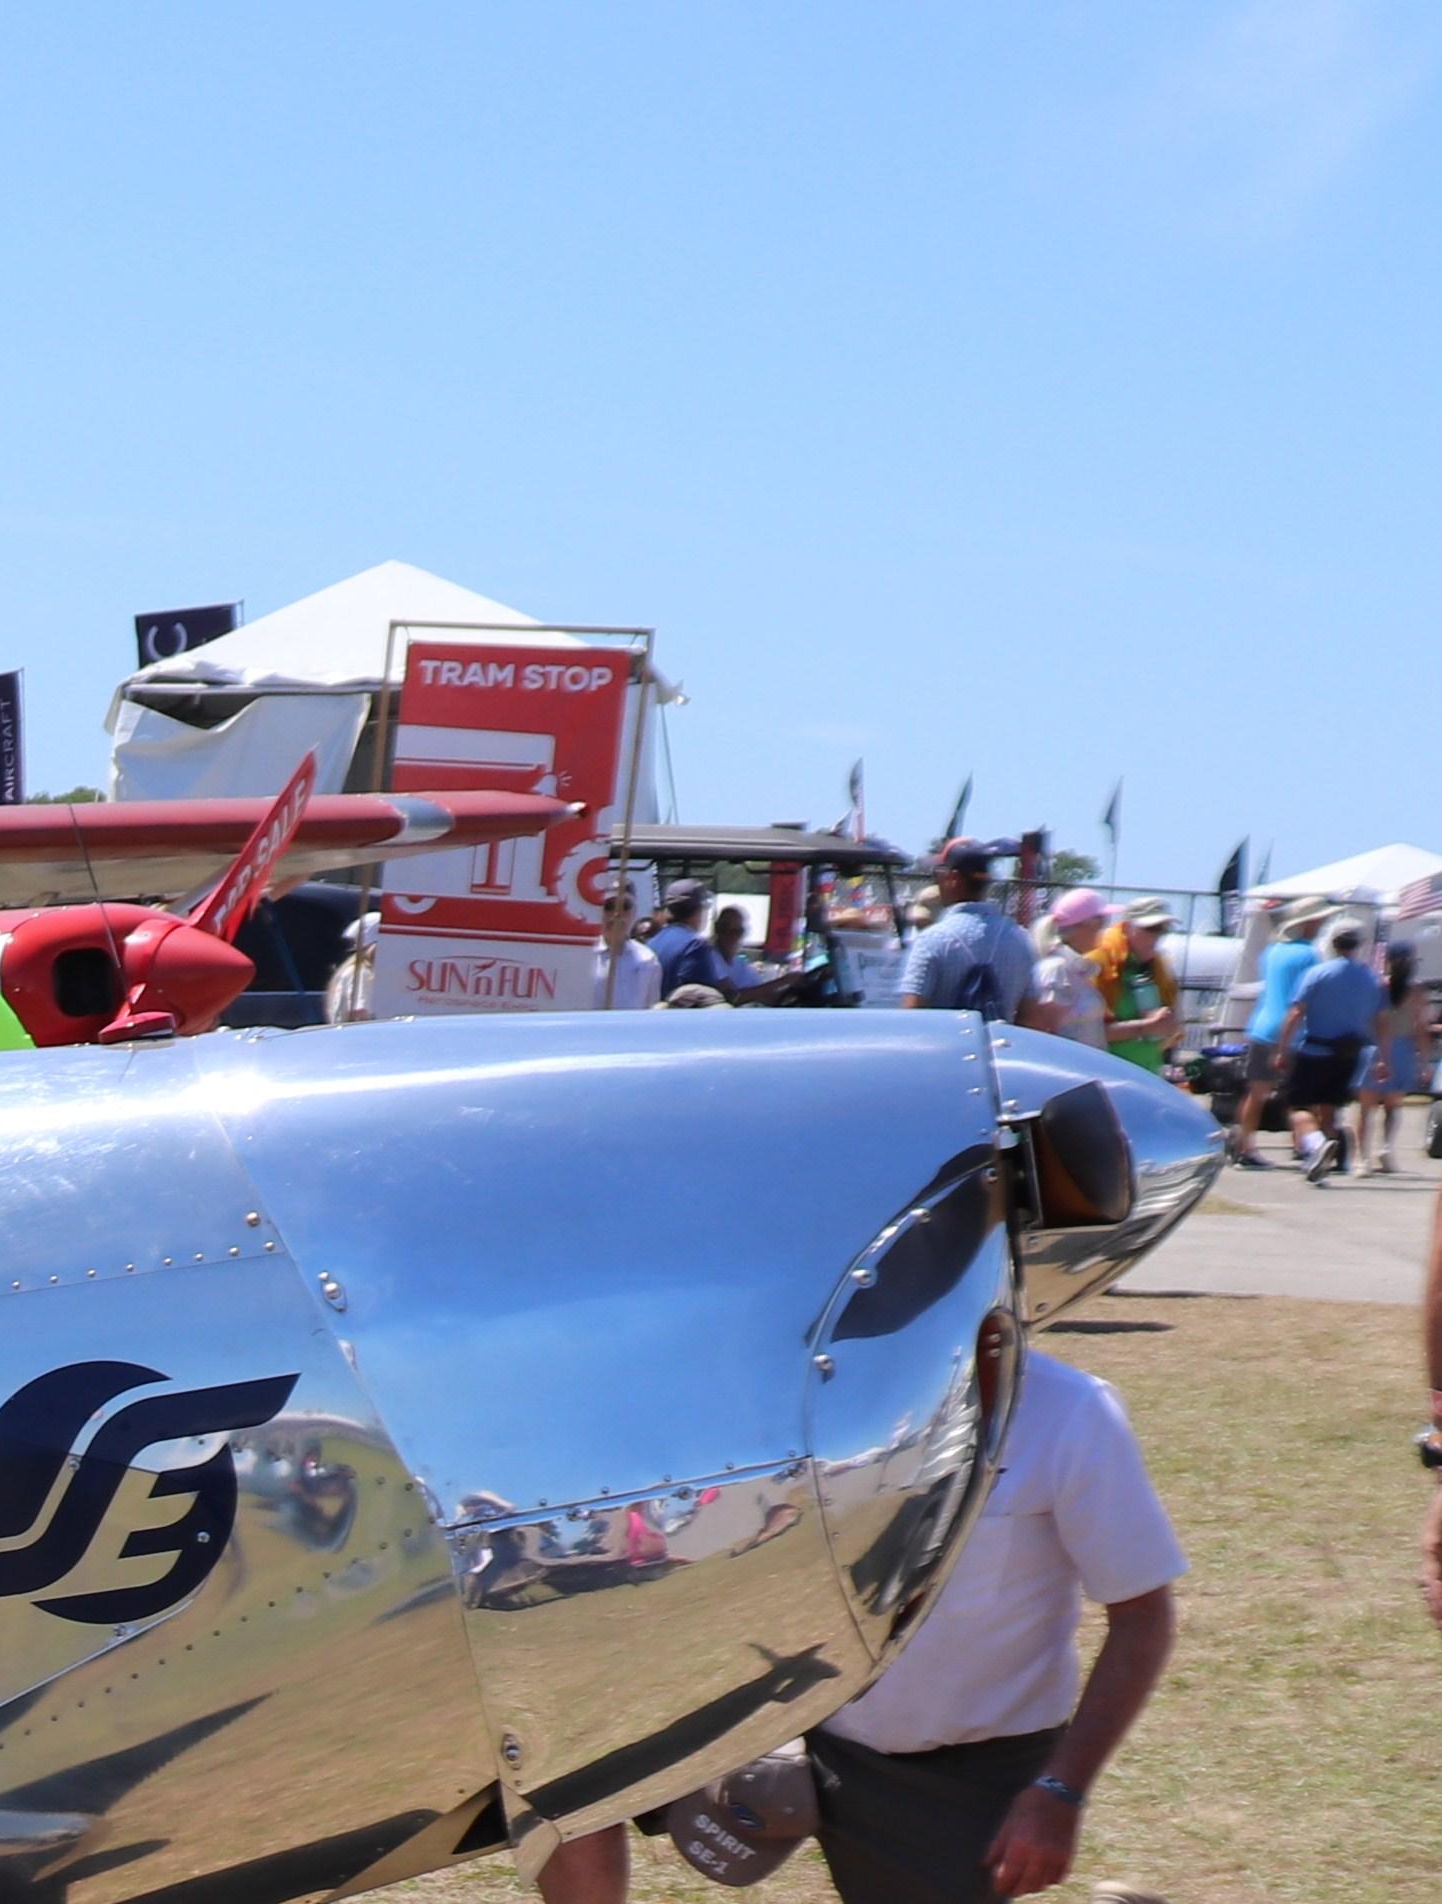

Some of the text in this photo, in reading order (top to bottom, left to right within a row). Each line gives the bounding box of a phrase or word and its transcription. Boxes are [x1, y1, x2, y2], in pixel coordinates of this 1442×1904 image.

[419, 659, 613, 692] TRAM STOP
[0, 698, 15, 801] AIRCRAFT
[694, 1813, 757, 1860] SPIRIT
[688, 1840, 729, 1875] SE-1
